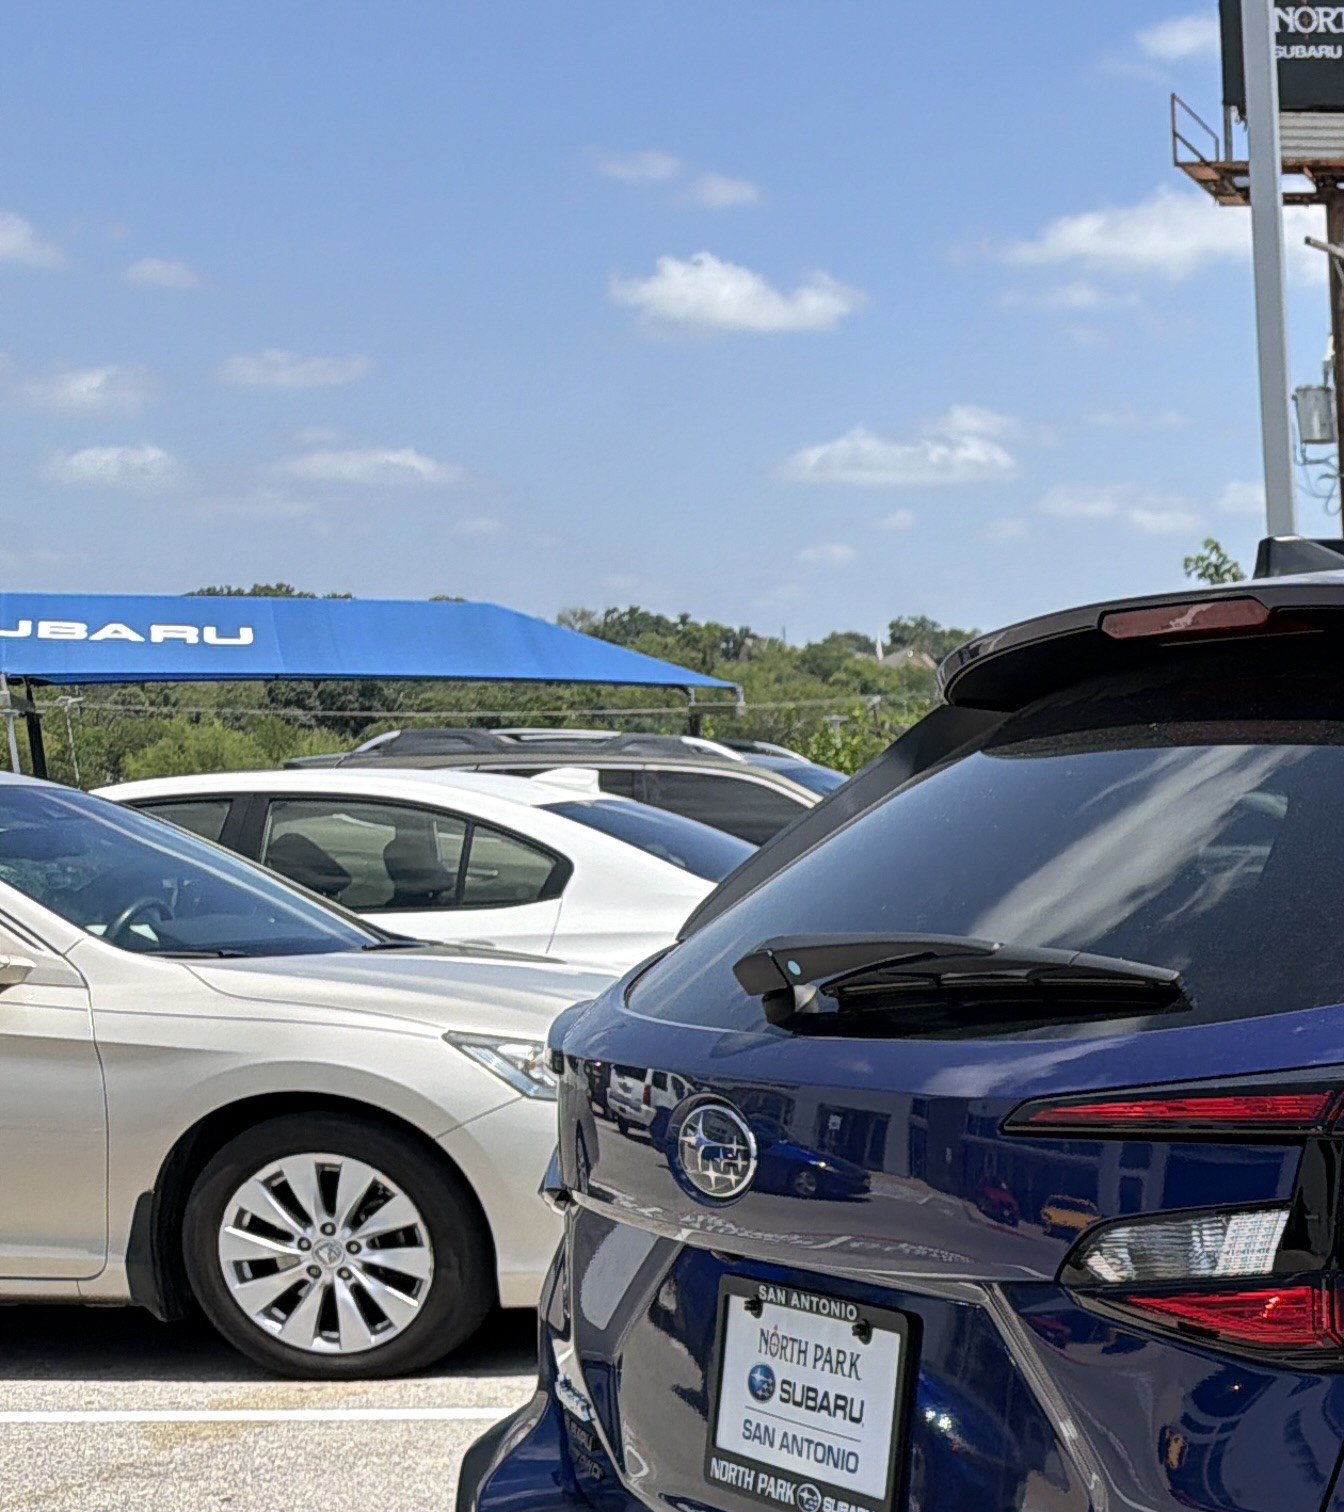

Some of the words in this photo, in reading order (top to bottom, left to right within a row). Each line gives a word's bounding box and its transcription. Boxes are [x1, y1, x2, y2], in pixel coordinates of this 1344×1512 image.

[1275, 45, 1342, 60] SUBARU
[758, 1284, 787, 1304] SAN
[791, 1292, 859, 1322] ANTONIO
[758, 1326, 808, 1367] NORTH
[813, 1345, 863, 1381] PARK
[779, 1380, 865, 1425] SUBARU
[742, 1419, 776, 1448] SAN
[779, 1431, 860, 1475] ANTONIO
[710, 1457, 753, 1489] NORTH
[757, 1474, 797, 1506] PARK
